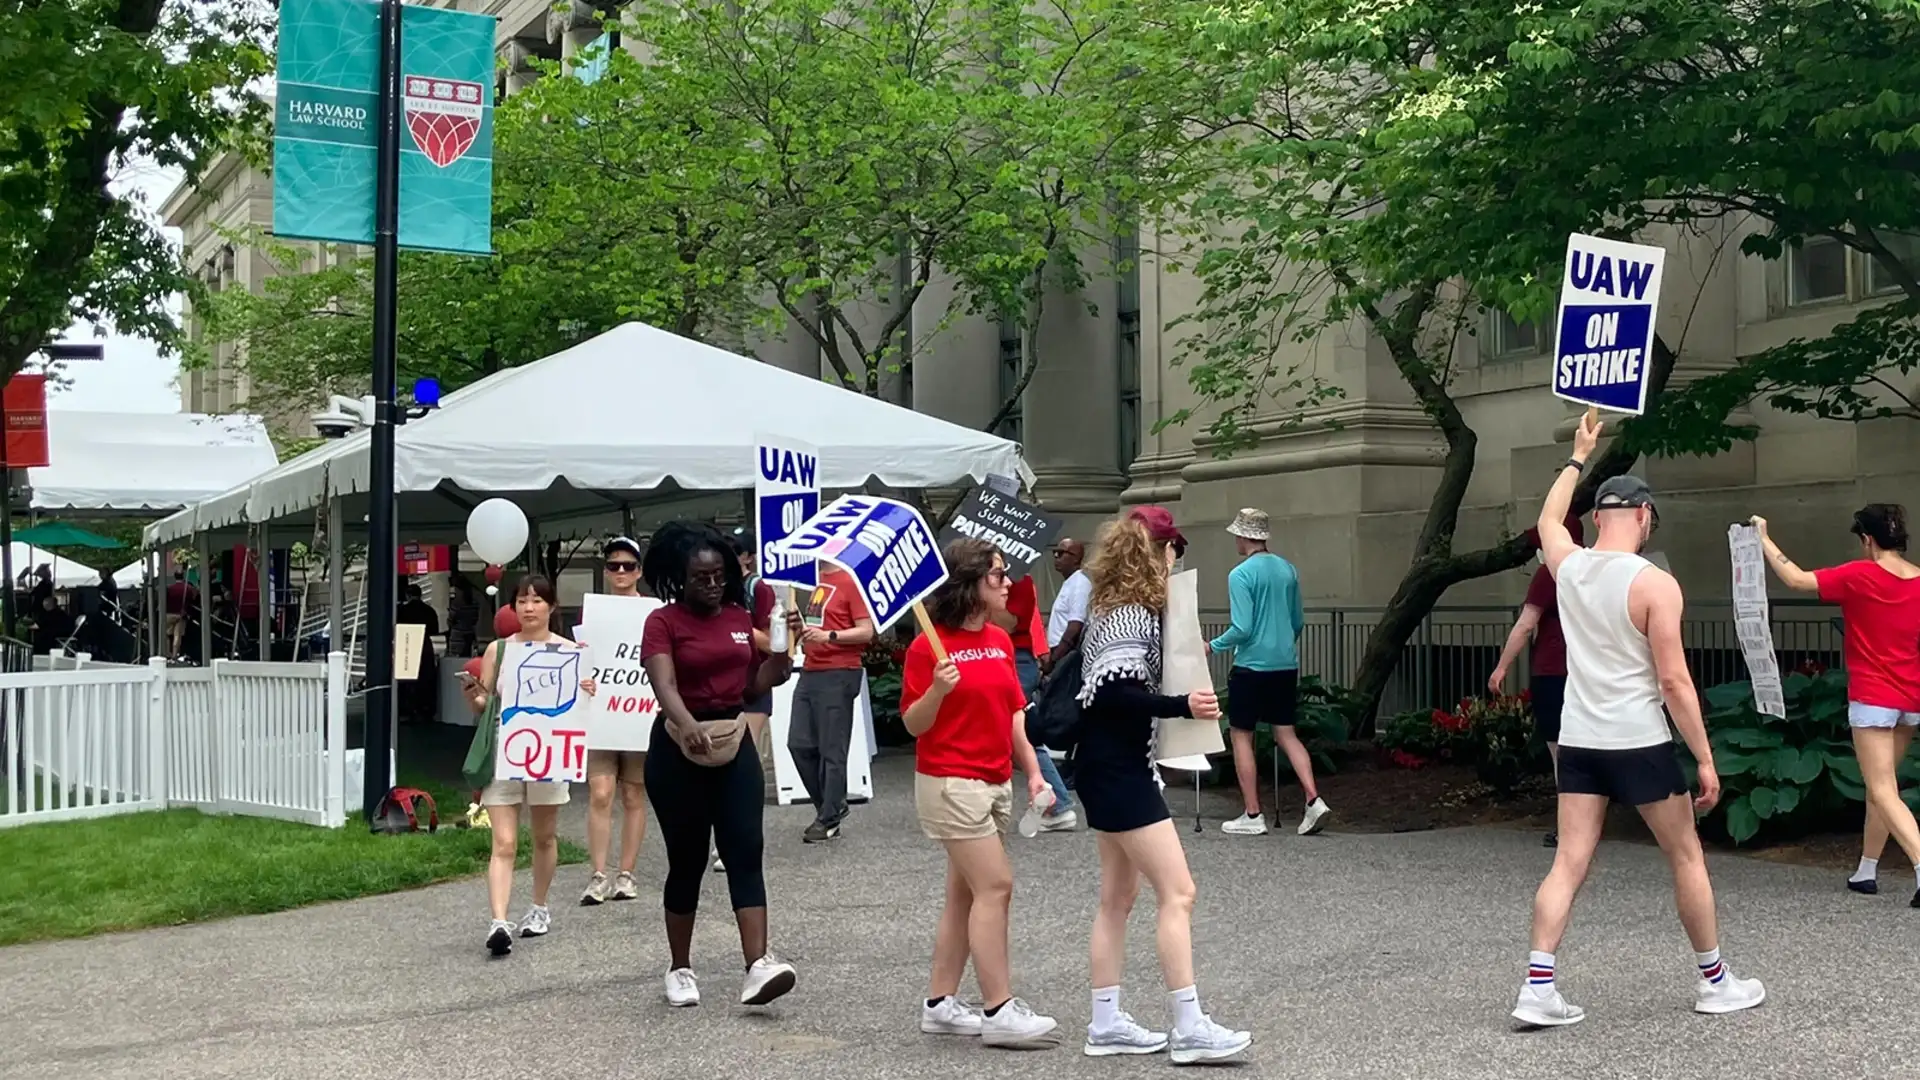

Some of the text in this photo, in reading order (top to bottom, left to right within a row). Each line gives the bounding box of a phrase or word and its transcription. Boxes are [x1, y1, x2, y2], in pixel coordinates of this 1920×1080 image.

[289, 100, 367, 120] HARVARD
[289, 113, 365, 130] LAW SCHOOL
[1570, 250, 1654, 300] UAW
[1585, 312, 1619, 349] ON
[1559, 348, 1641, 388] STRIKE
[760, 446, 816, 488] UAW
[782, 499, 803, 534] ON
[788, 499, 872, 550] UAW
[977, 508, 1036, 539] SURVIVE!
[979, 490, 1047, 529] WE WANT TO
[856, 519, 897, 558] ON
[868, 520, 931, 617] STRIKE
[523, 671, 557, 697] ICE
[504, 729, 586, 779] OUT!
